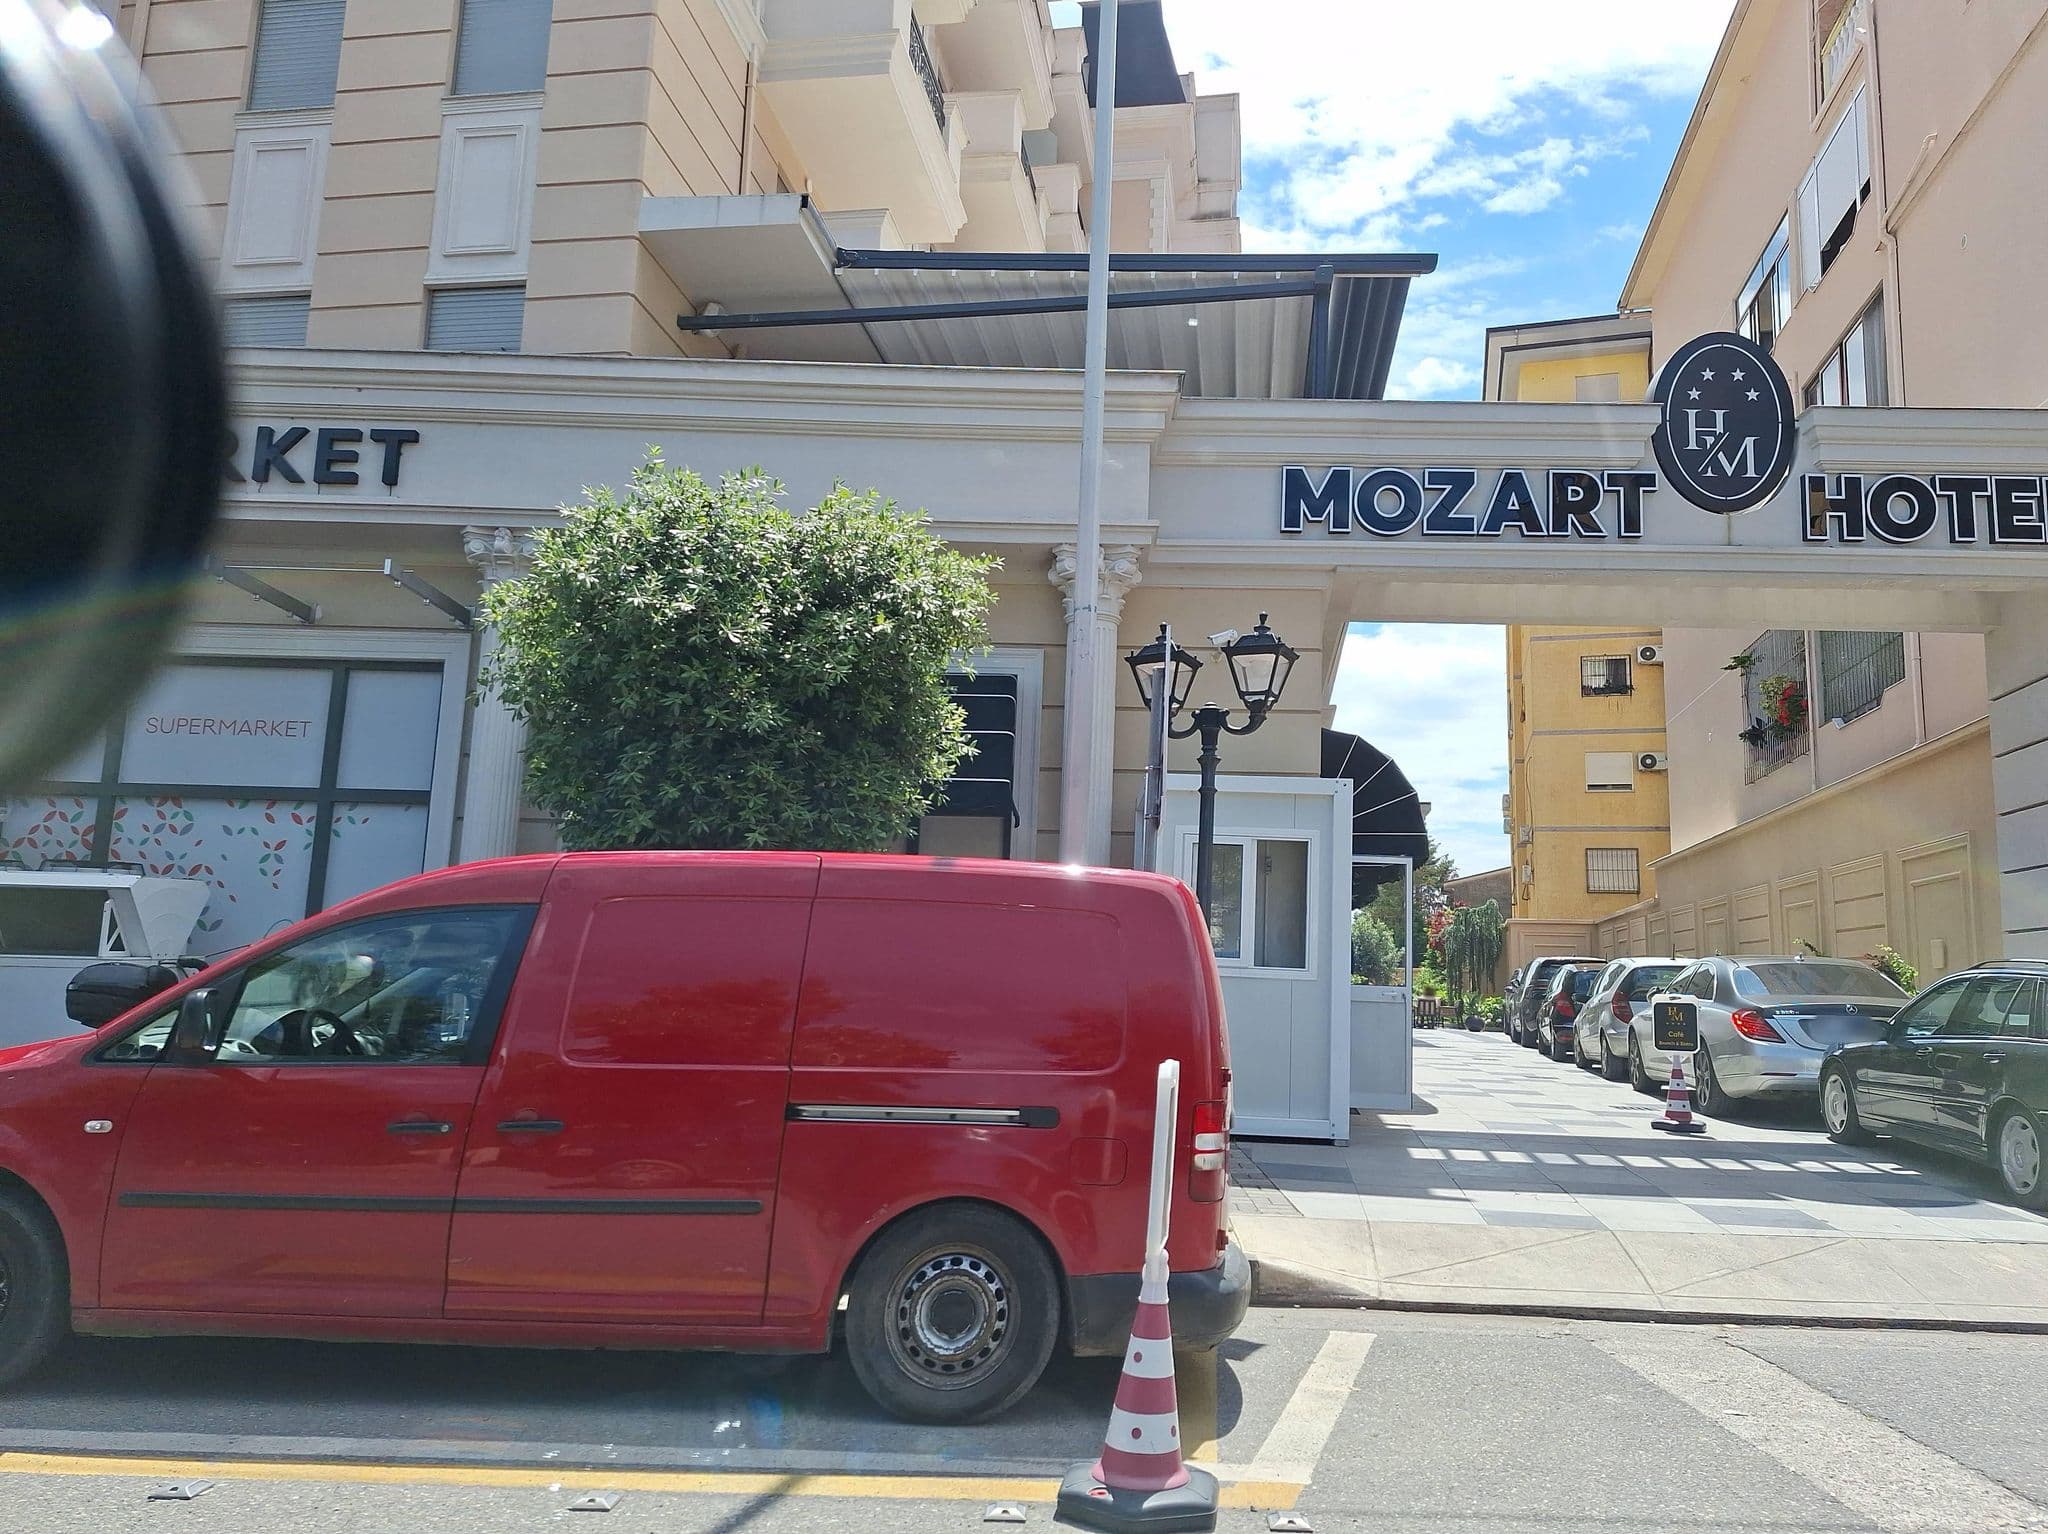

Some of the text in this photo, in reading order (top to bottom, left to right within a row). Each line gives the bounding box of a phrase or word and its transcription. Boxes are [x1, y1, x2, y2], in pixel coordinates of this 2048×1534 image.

[1280, 465, 2048, 545] MOZART HOTE
[145, 716, 312, 738] SUPERMARKET
